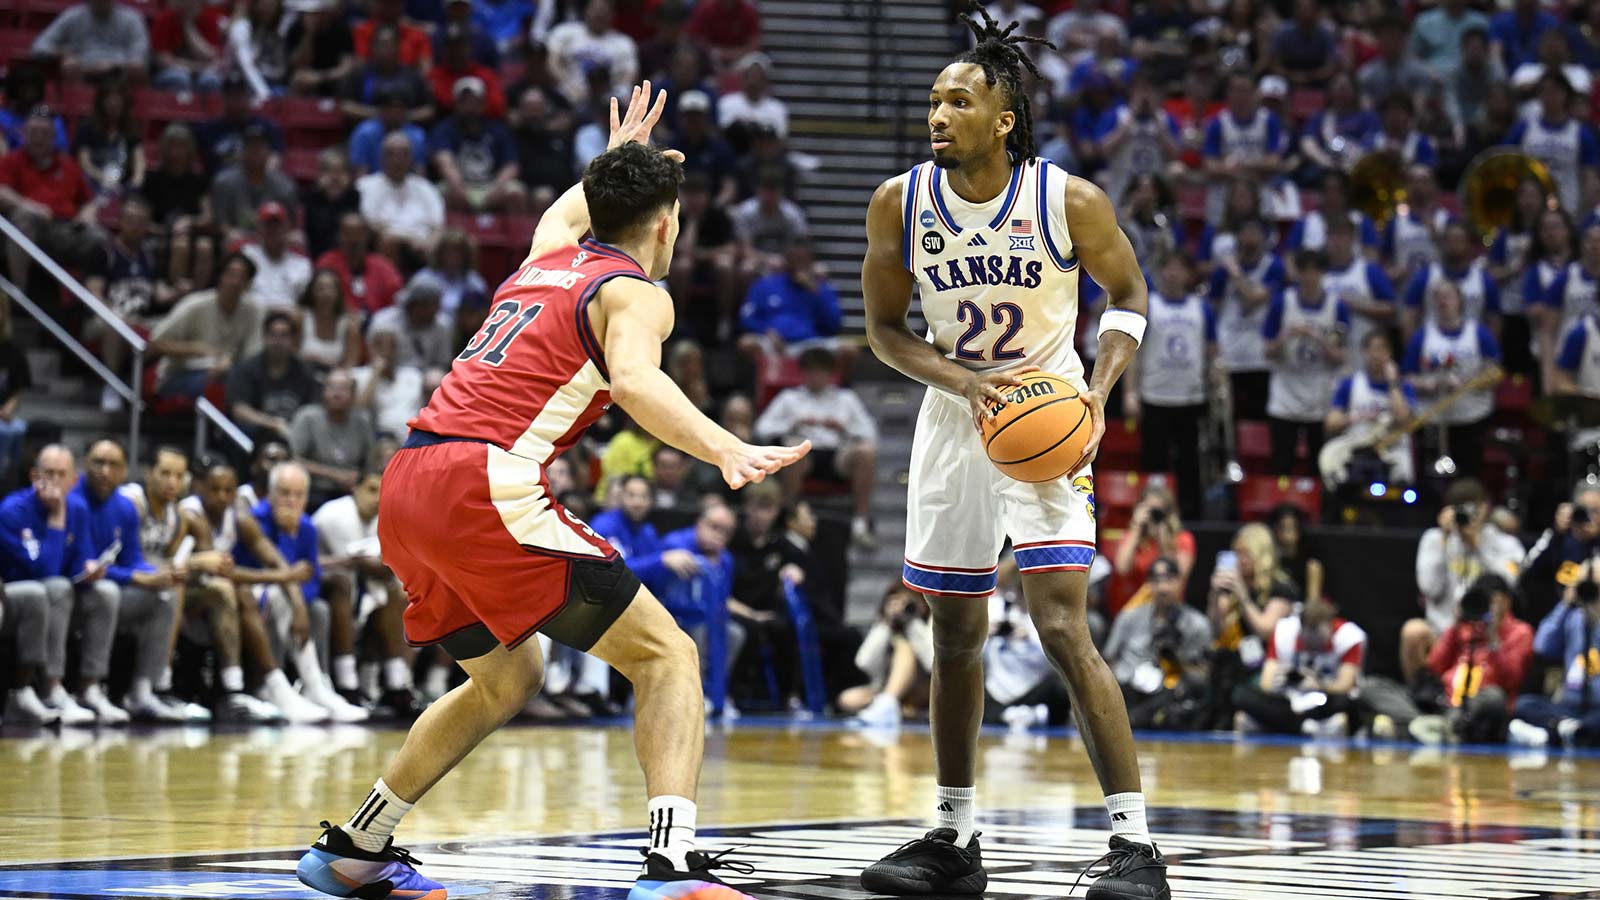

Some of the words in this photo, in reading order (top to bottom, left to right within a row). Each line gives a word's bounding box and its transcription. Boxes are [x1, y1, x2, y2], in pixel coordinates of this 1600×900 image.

[924, 236, 941, 250] SW
[923, 255, 1042, 291] KANSAS
[456, 300, 544, 367] 31
[956, 299, 1026, 361] 22
